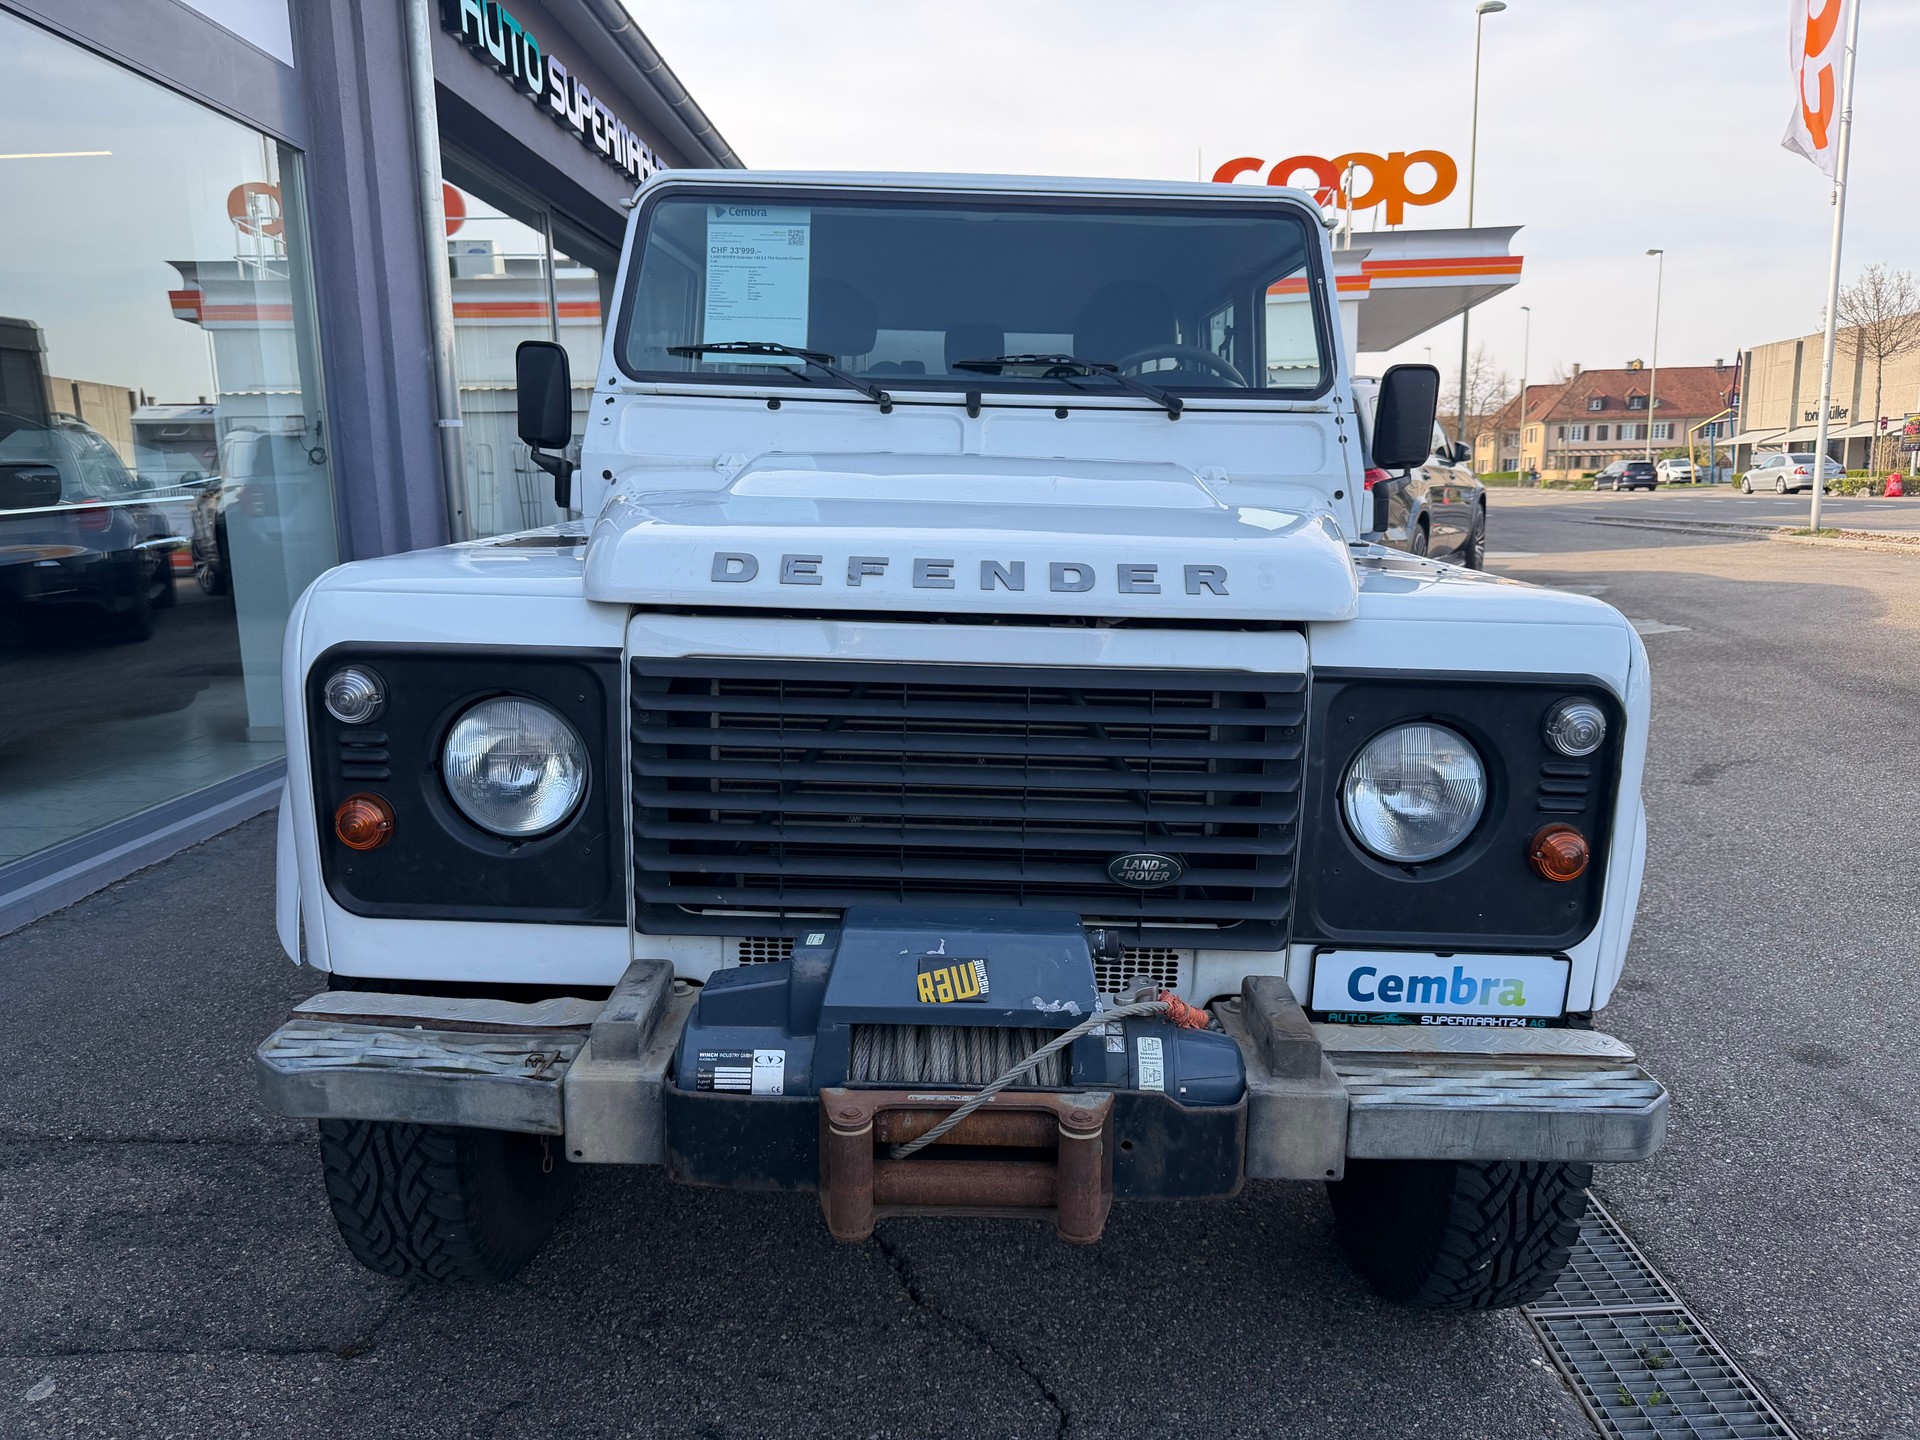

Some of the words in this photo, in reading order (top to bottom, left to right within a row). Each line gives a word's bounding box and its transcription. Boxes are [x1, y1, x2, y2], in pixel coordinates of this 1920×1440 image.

[460, 0, 543, 94] AUTO
[728, 207, 768, 217] Cembra
[711, 246, 728, 255] CHF
[1829, 405, 1849, 420] üller
[711, 552, 1229, 596] DEFENDER
[1122, 859, 1160, 870] LAND
[1125, 870, 1170, 881] ROVER
[1347, 966, 1526, 1007] Cembra
[1328, 1013, 1368, 1023] AUTO
[1529, 1019, 1546, 1028] AG
